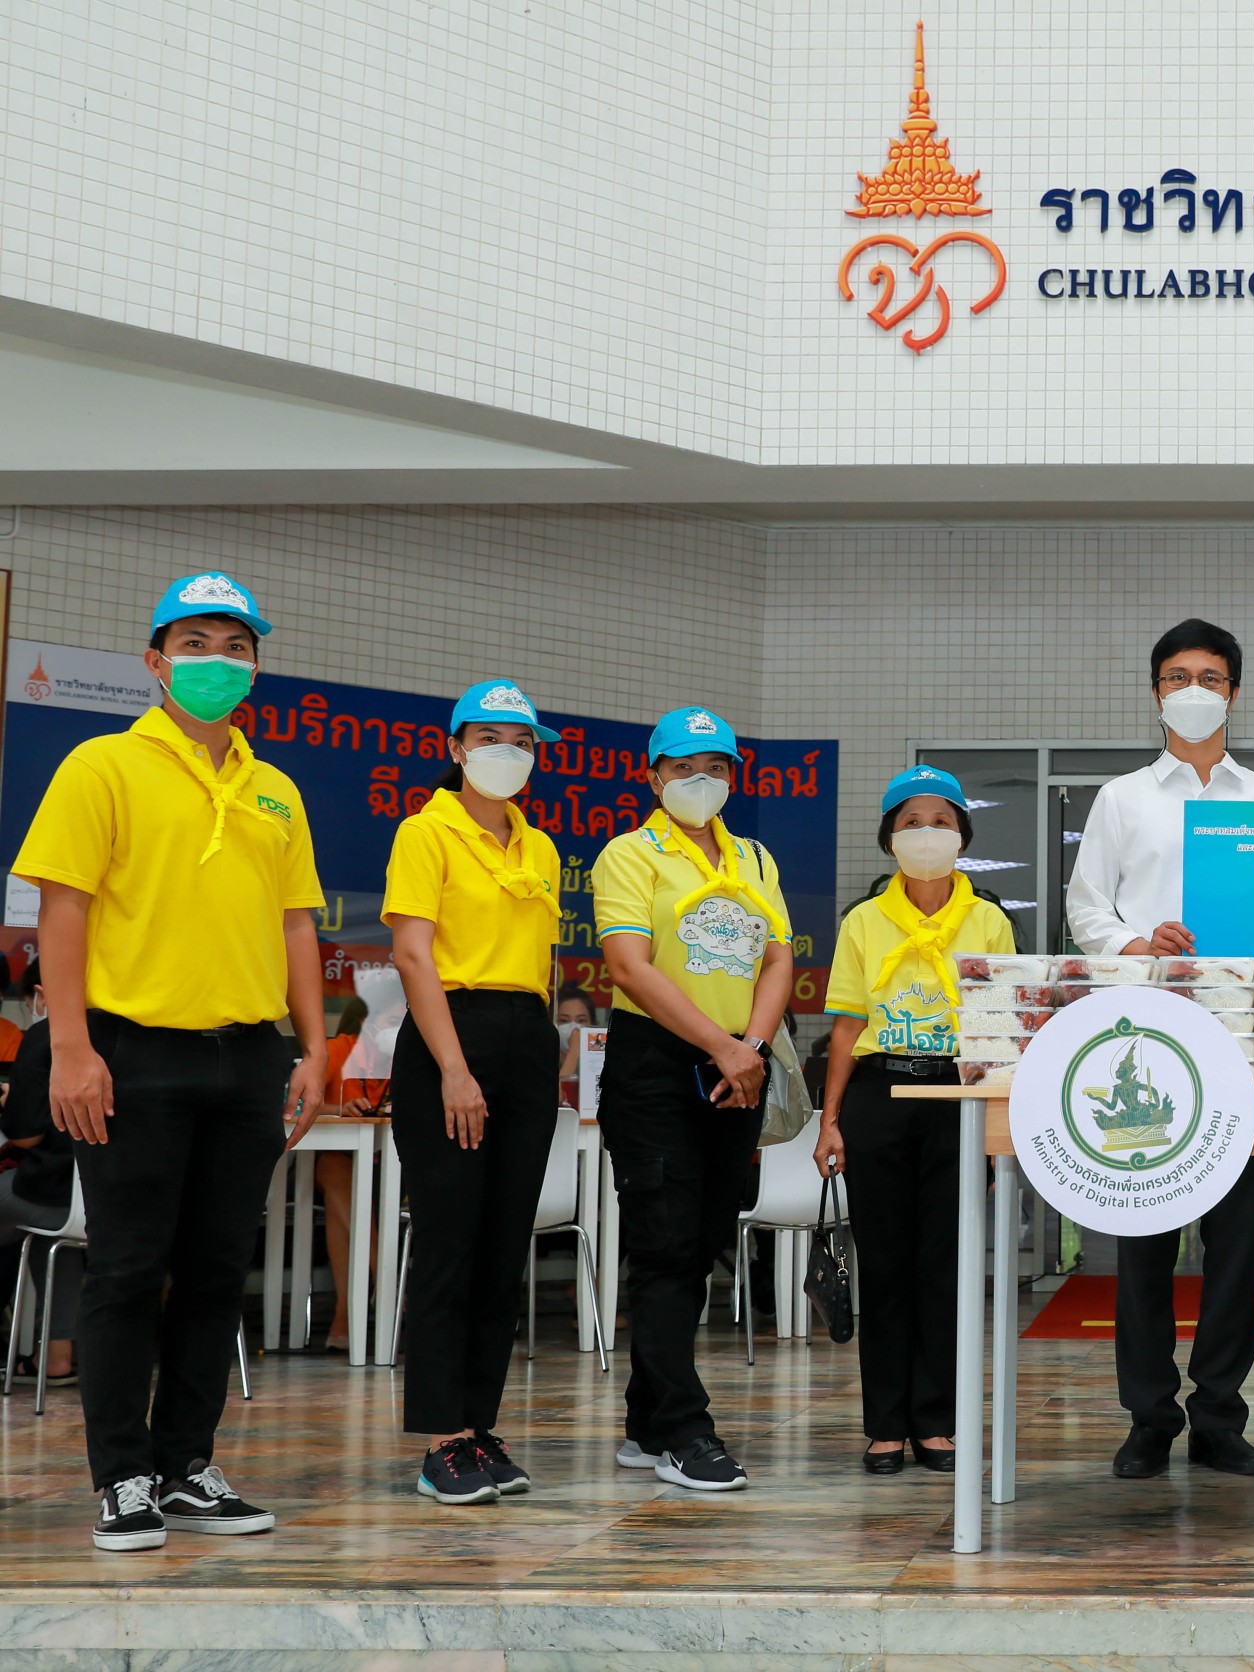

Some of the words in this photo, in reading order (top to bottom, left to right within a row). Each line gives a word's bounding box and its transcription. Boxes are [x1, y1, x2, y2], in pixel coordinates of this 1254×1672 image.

[1031, 1135, 1069, 1185] Ministry
[1069, 1182, 1085, 1201] of
[1085, 1189, 1129, 1208] Digital
[1134, 1182, 1194, 1209] Economy
[1193, 1163, 1216, 1184] and
[1212, 1113, 1241, 1162] Society
[1044, 1109, 1223, 1193] กระทรวงดิจิทัลเพื่อเศรษฐกิจและสังคม
